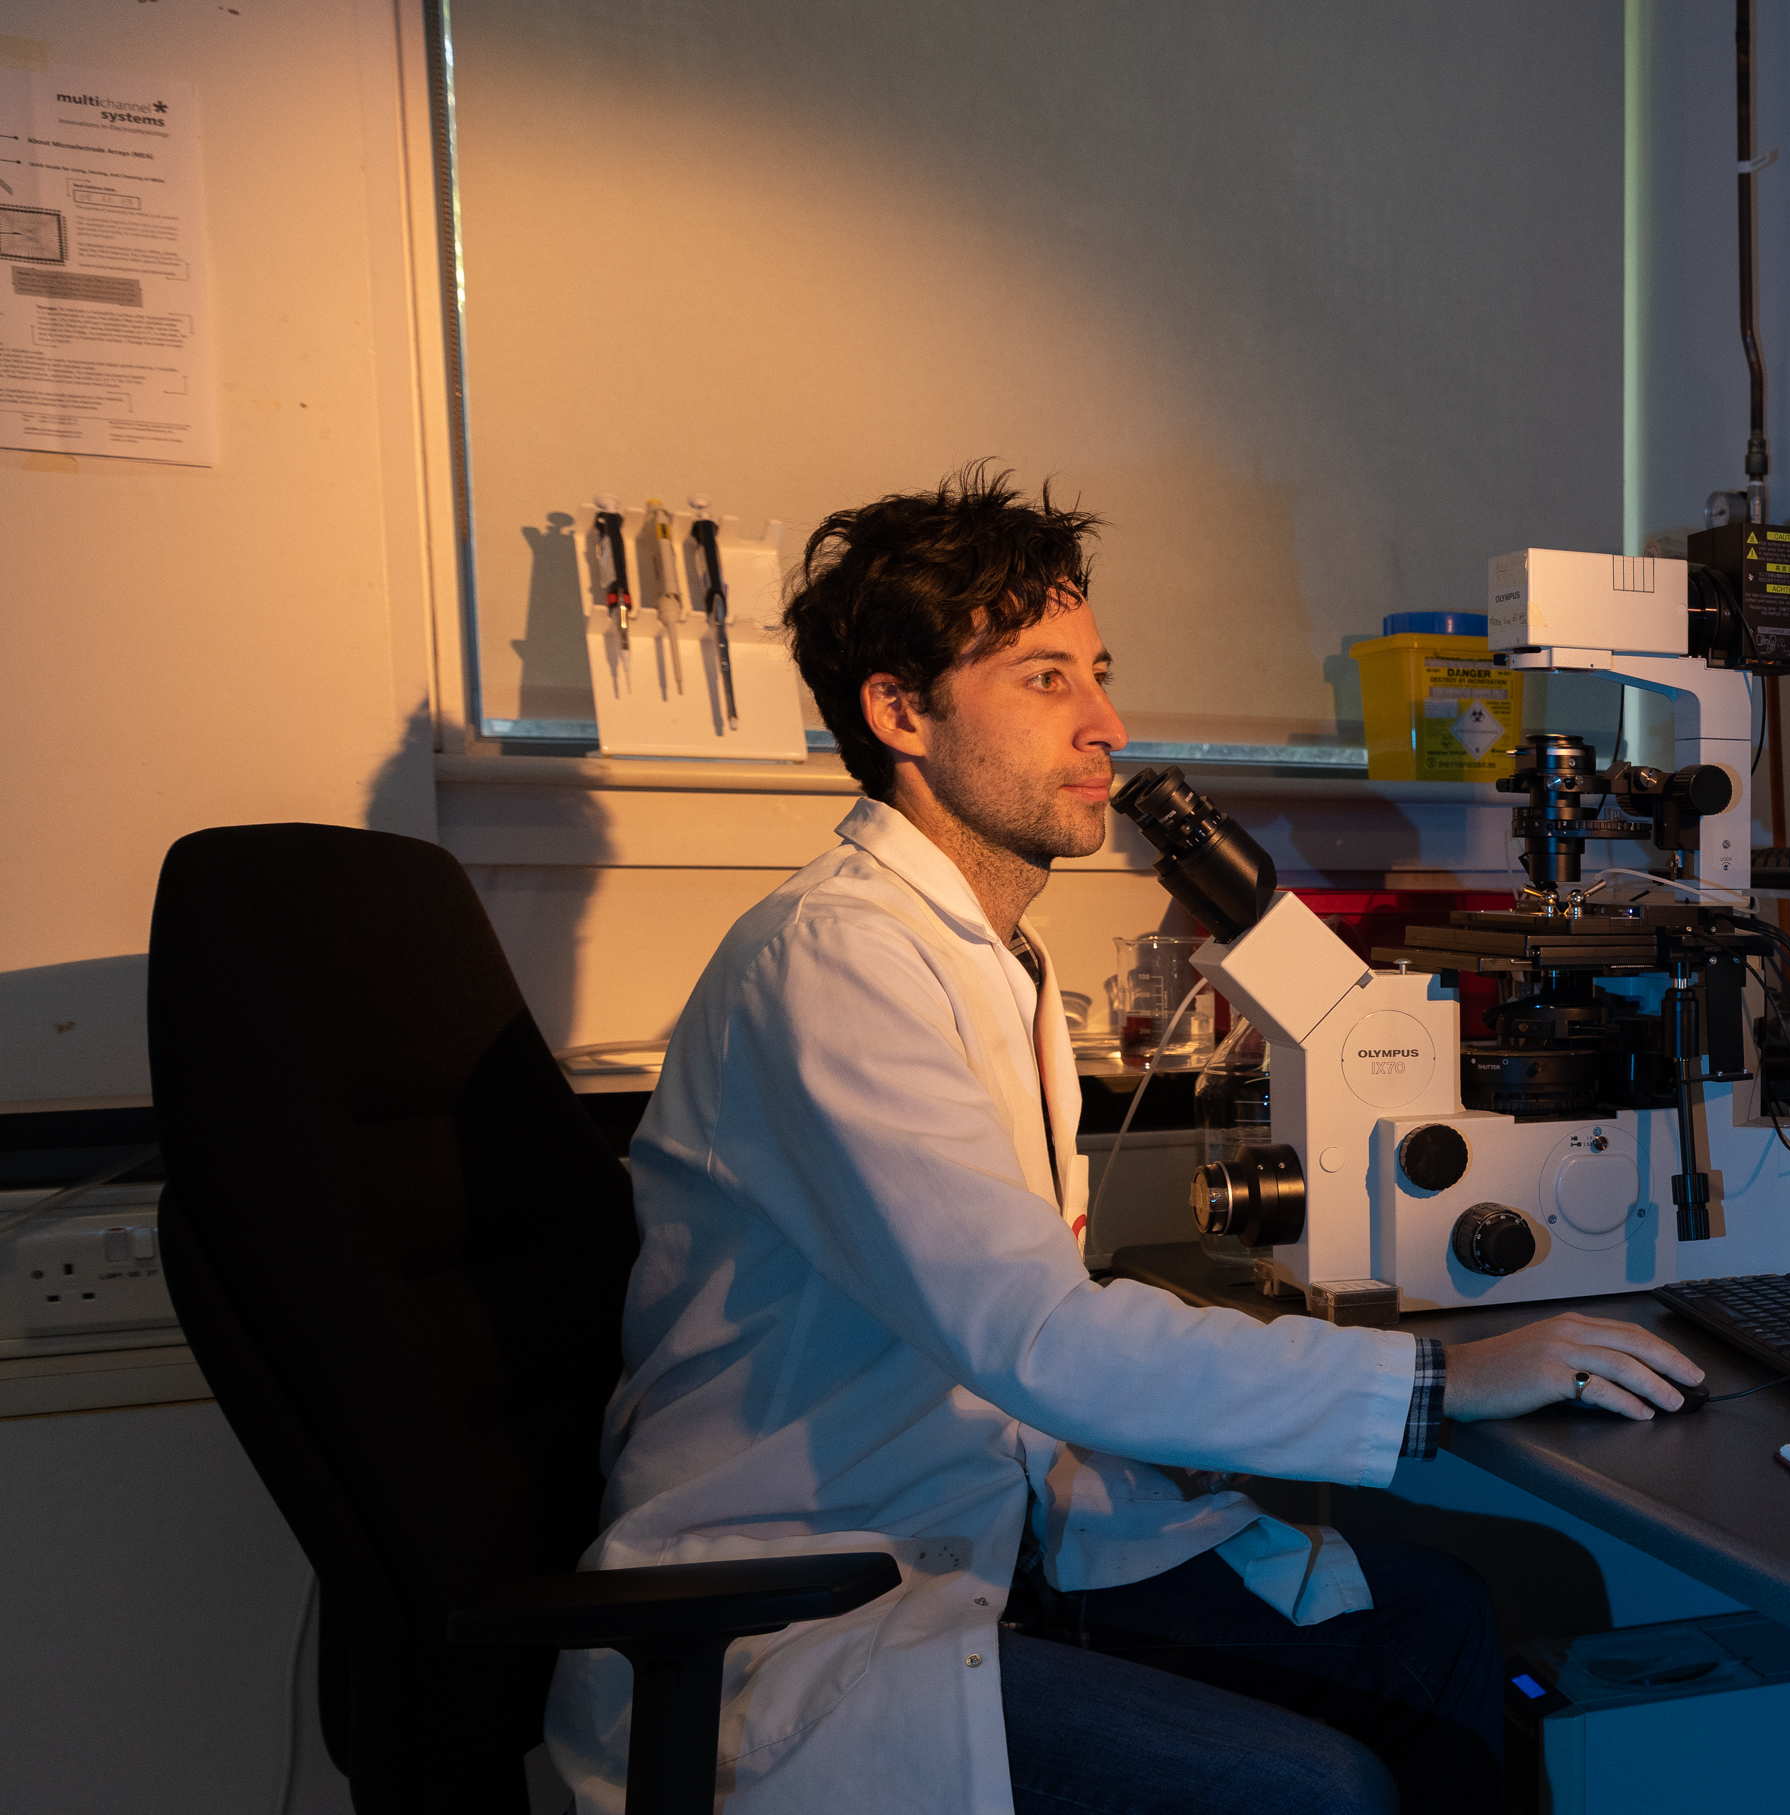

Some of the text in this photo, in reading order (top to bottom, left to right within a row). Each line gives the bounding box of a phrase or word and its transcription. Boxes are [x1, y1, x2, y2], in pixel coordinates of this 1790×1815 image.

[56, 93, 152, 113] multichannel
[100, 110, 165, 127] systems
[28, 137, 51, 146] About
[51, 141, 106, 153] Microelectrode
[1495, 591, 1521, 603] OLYMPUS
[1447, 669, 1491, 678] DANGER
[1358, 1049, 1419, 1058] OLYMPUS
[1371, 1061, 1405, 1074] IX70
